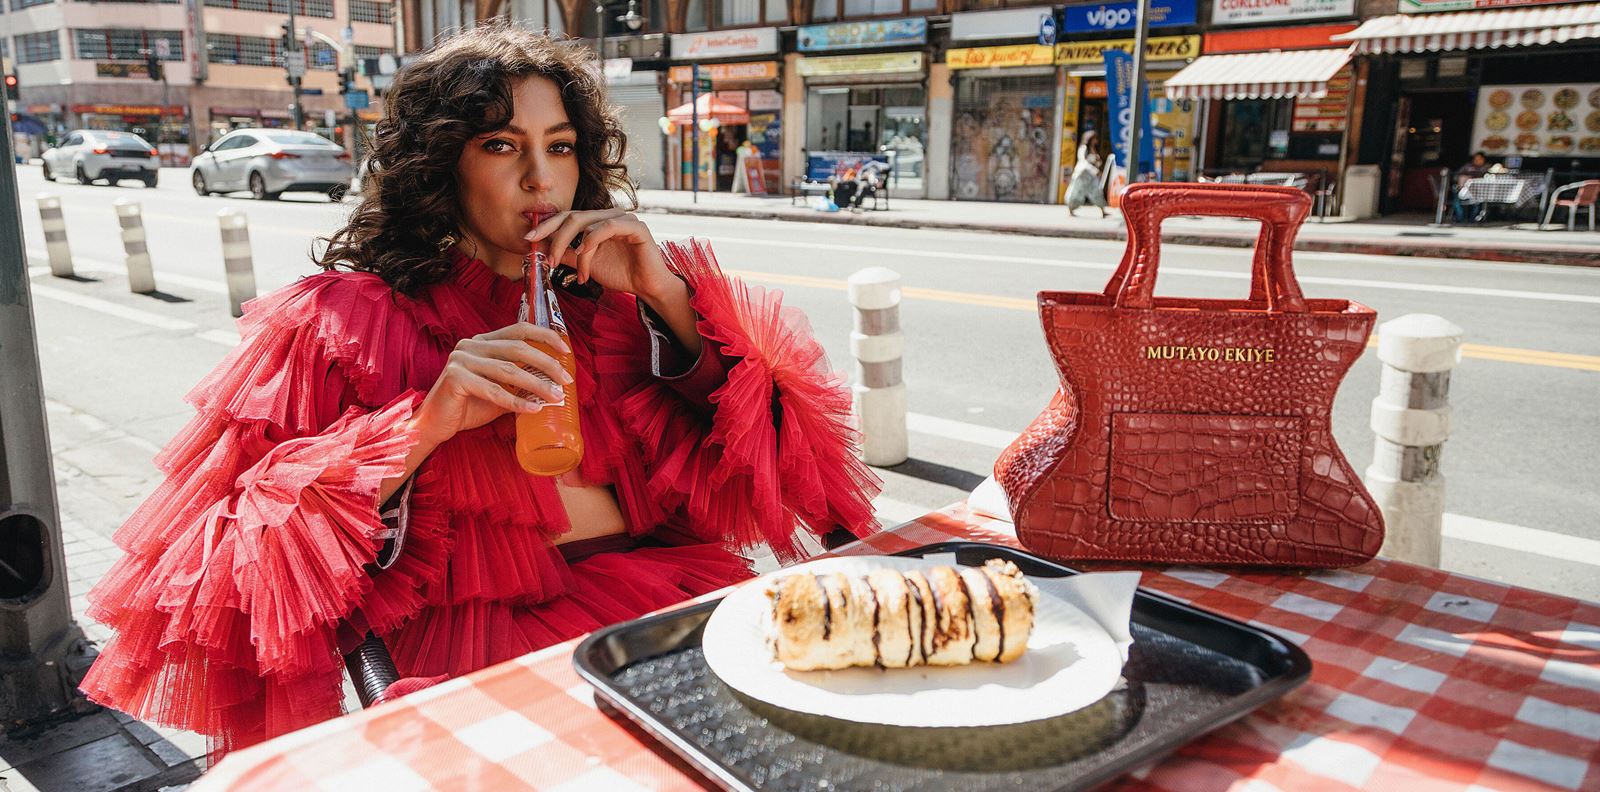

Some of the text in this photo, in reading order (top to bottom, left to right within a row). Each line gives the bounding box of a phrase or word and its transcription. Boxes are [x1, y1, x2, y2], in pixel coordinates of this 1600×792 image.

[1087, 6, 1131, 29] vigo
[1147, 346, 1275, 362] MUTAYO EKIYE
